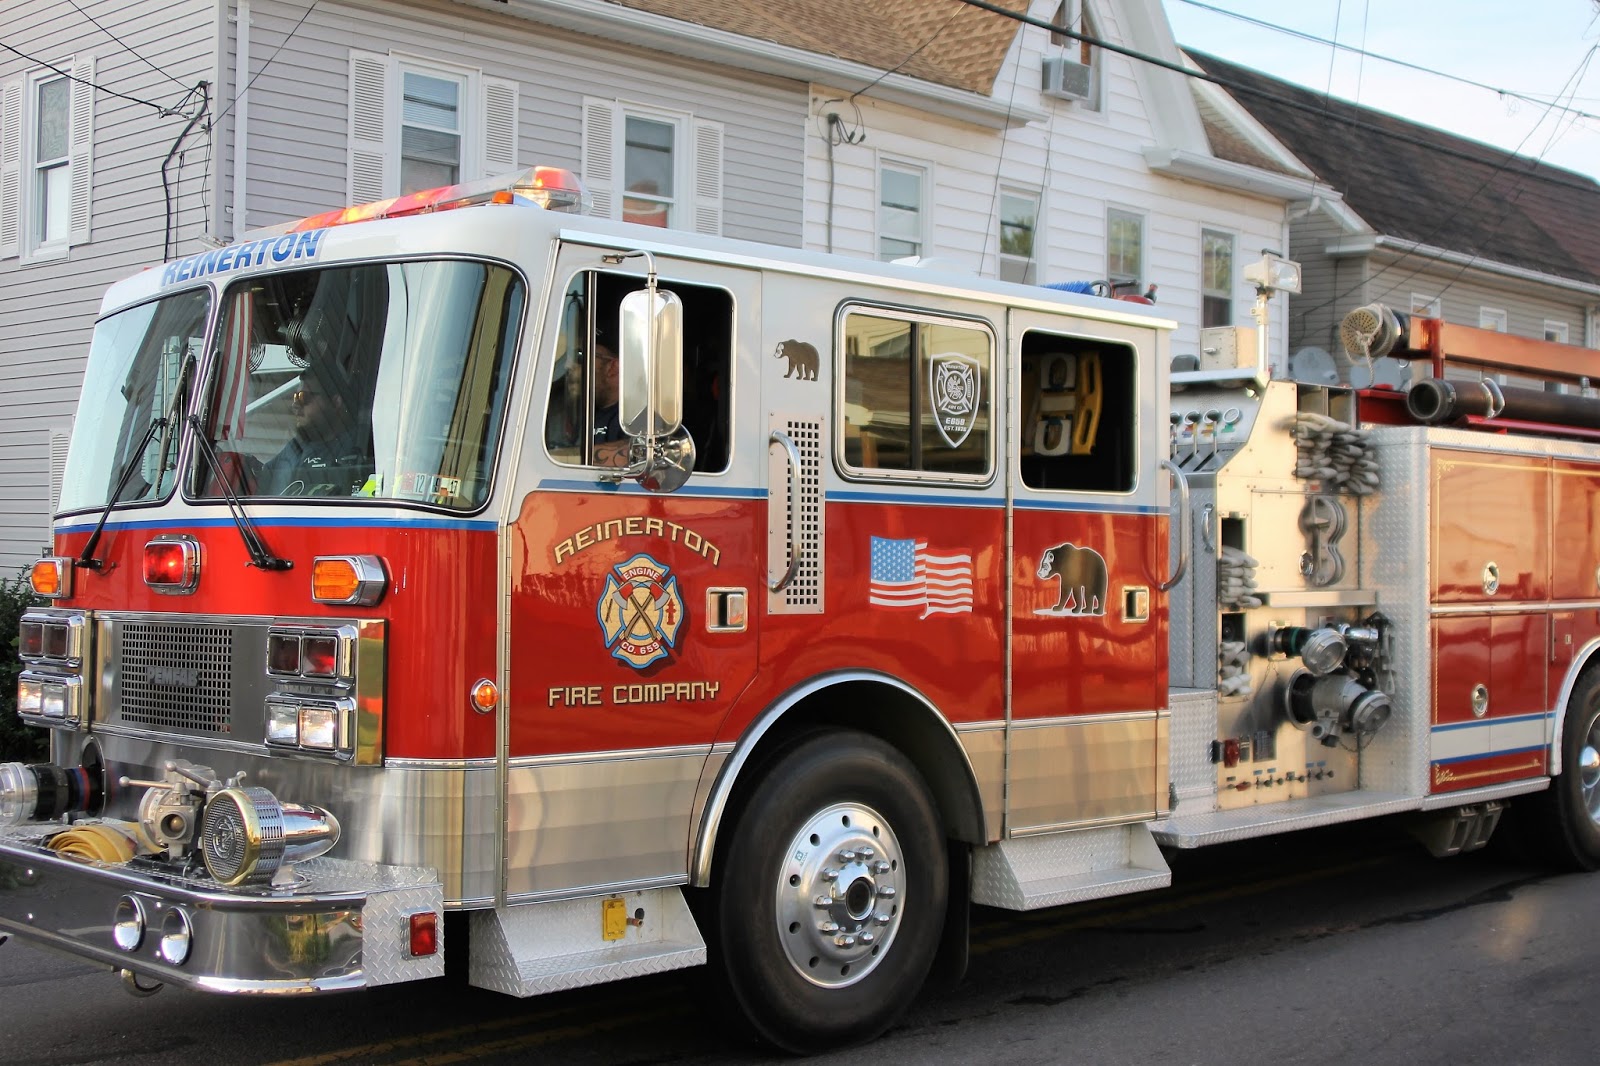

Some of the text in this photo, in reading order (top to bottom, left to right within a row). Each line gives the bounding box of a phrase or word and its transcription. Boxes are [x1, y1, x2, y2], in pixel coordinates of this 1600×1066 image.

[162, 229, 325, 287] REINERTON
[415, 474, 425, 494] 12
[449, 480, 459, 494] 17
[554, 516, 721, 566] REINERTON
[623, 567, 659, 580] ENGINE
[621, 641, 660, 655] CO. 659
[147, 666, 199, 687] PEMFAB
[548, 681, 720, 707] FIRE COMPANY
